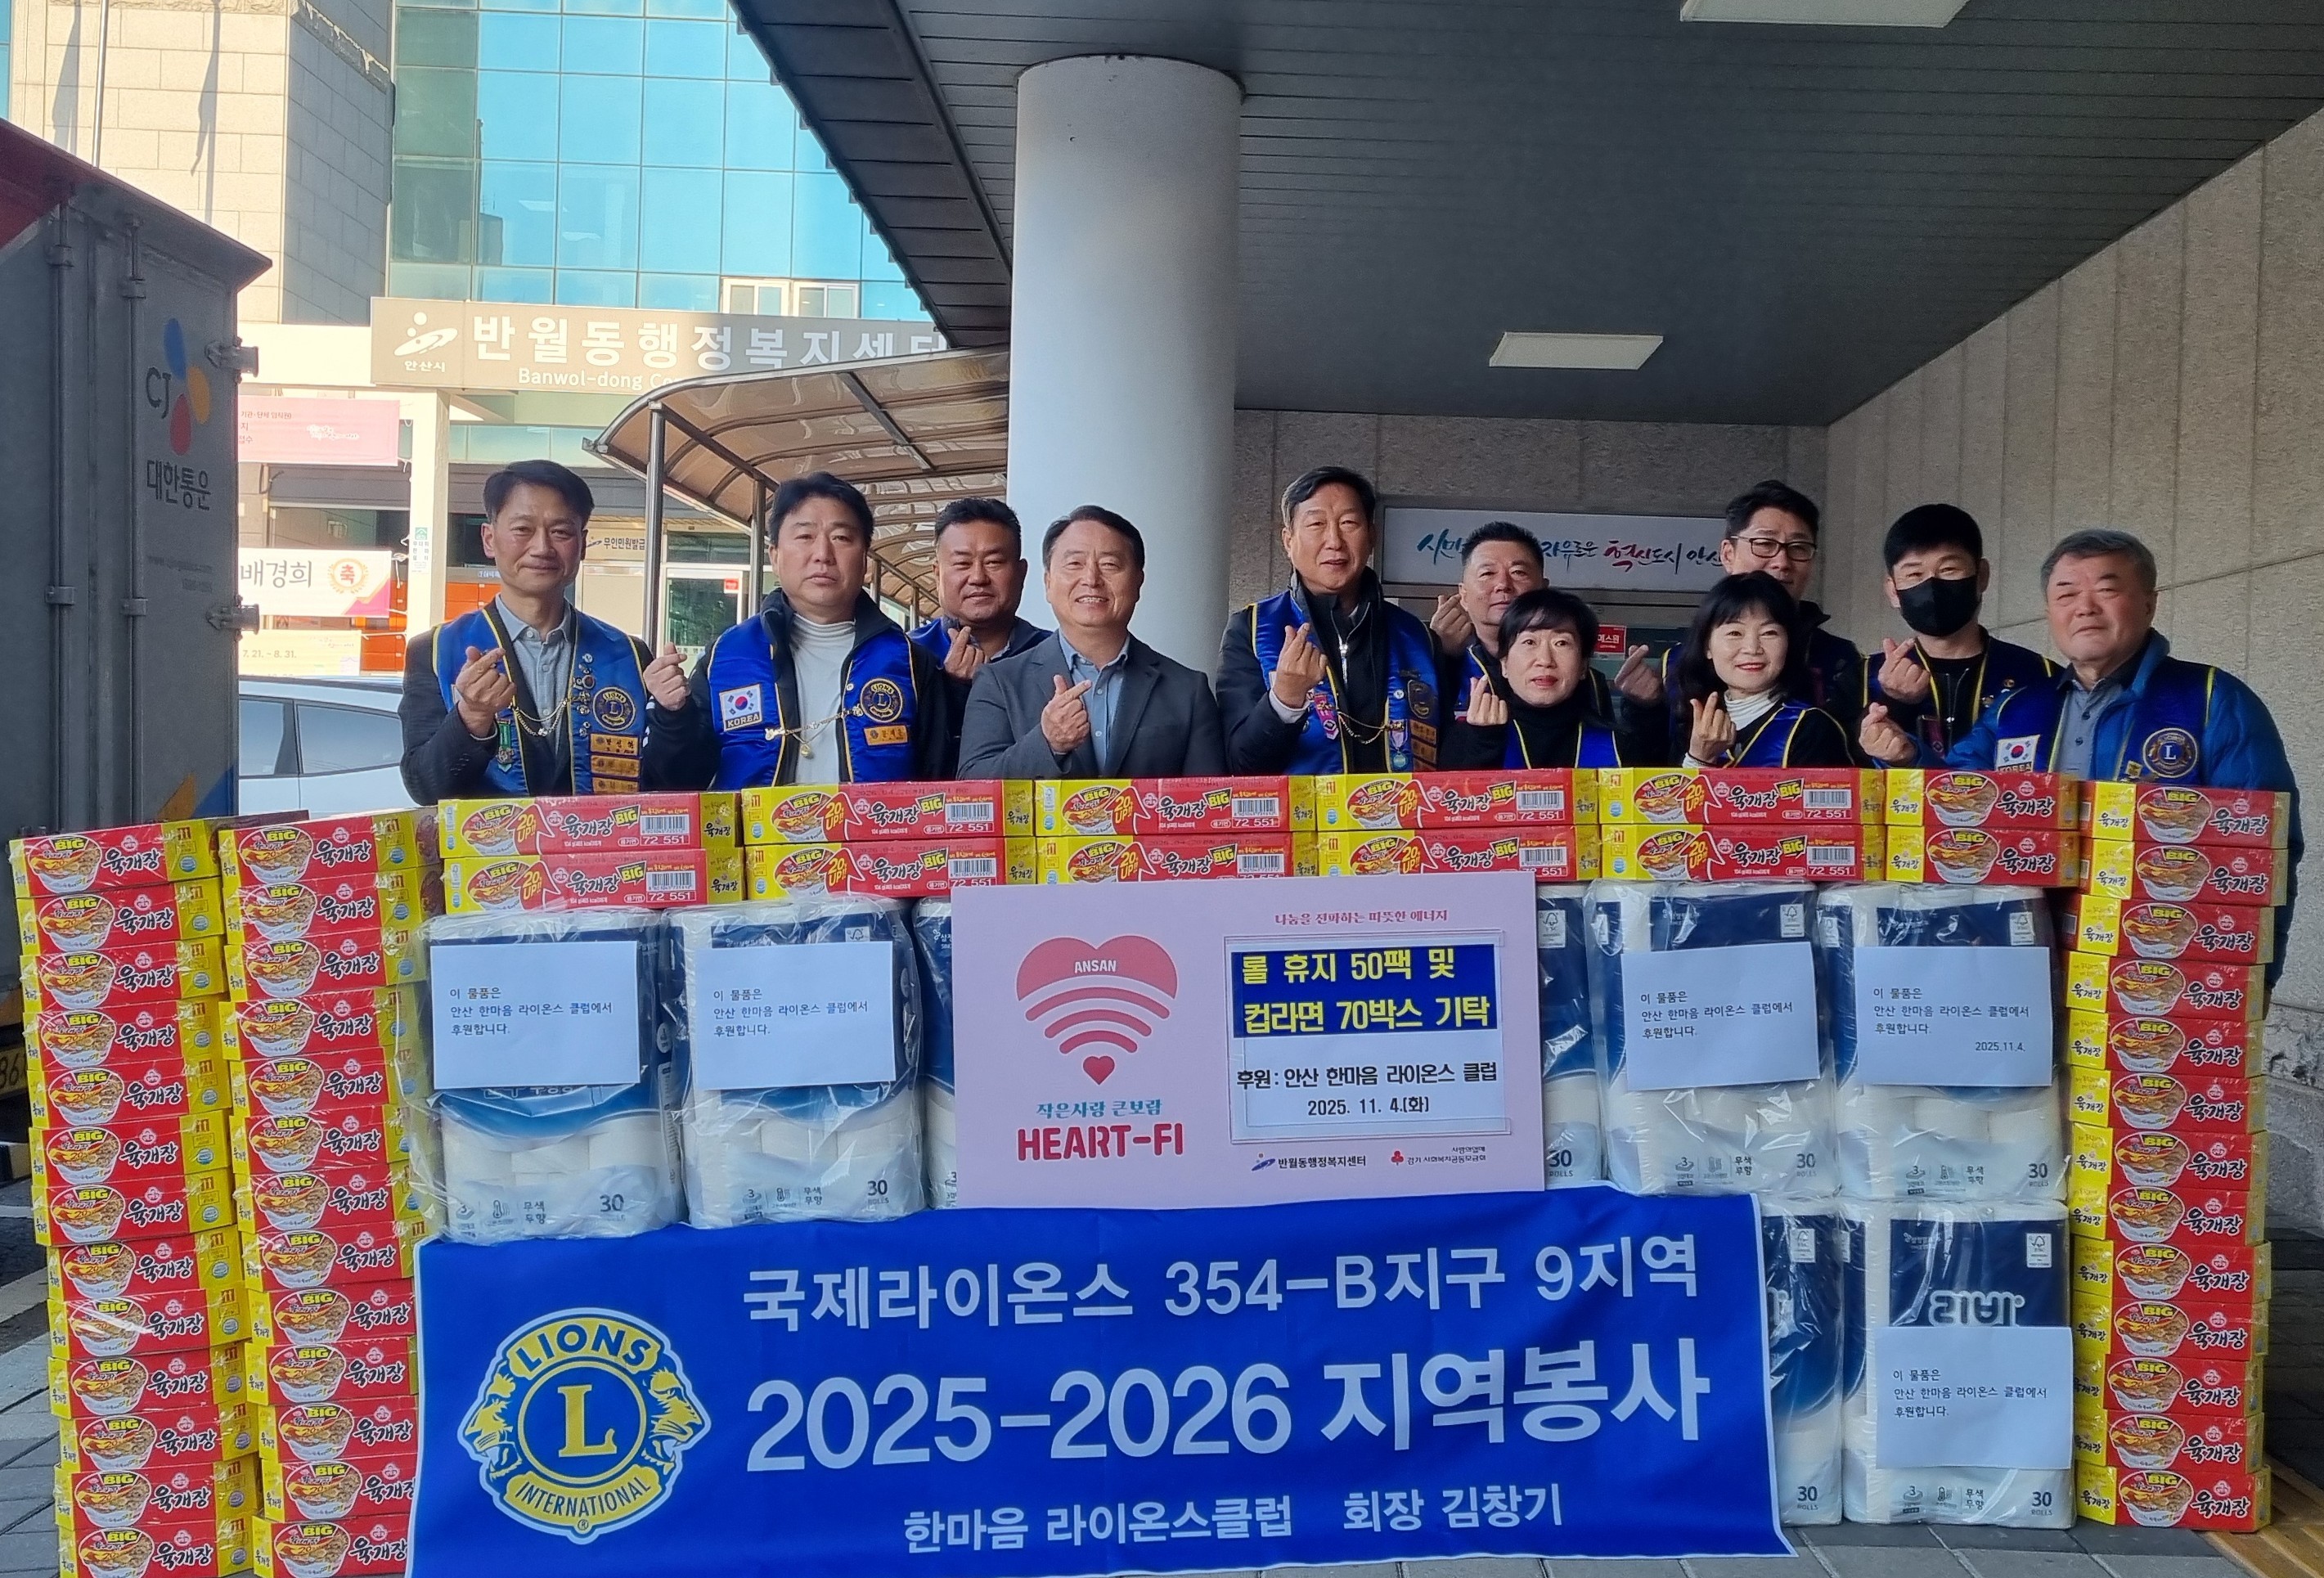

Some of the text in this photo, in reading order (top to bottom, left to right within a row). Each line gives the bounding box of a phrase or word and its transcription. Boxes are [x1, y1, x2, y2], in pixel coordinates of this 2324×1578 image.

[518, 366, 643, 390] Banwol-dong
[146, 460, 212, 511] 대한통운
[240, 558, 312, 588] 배경희
[727, 713, 760, 729] KOREA
[2164, 745, 2178, 760] L
[1443, 785, 1513, 813] 육개장 BIG
[1728, 783, 1801, 807] 육개장 BIG
[869, 798, 943, 825] 육개장 BIG
[1158, 793, 1229, 819] 육개장 BIG
[1807, 810, 1848, 819] 72 551
[1997, 792, 2056, 818] 육개장
[562, 809, 636, 837] 육개장 BIG
[949, 823, 990, 833] 72 551
[2209, 808, 2268, 834] 육개장
[55, 838, 84, 851] BIG
[641, 835, 683, 844] 72 551
[102, 848, 160, 875] 육개장
[314, 838, 371, 866] 육개장
[1274, 906, 1448, 927] 나눔을 전파하는 따뜻한 에너지
[1074, 958, 1117, 974] ANSAN
[1242, 947, 1455, 985] 롤 휴지 50팩 및
[450, 986, 502, 1000] 이 물품은
[712, 987, 762, 1002] 이 물품은
[1639, 991, 1688, 1005] 이 물품은
[1872, 987, 1922, 1000] 이 물품은
[2182, 981, 2242, 1010] 육개장
[451, 1001, 614, 1018] 안산 한마음 라이온스 클럽에서
[713, 1001, 869, 1020] 안산 한마음 라이온스 클럽에서
[1243, 995, 1490, 1034] 컵라면 70박스 기탁
[1641, 1000, 1793, 1023] 안산 한마음 라이온스 클럽에서
[1873, 1003, 2030, 1018] 안산 한마음 라이온스 클럽에서
[115, 1023, 174, 1051] 육개장
[451, 1022, 511, 1036] 후원합니다.
[713, 1024, 771, 1038] 후원합니다.
[1642, 1024, 1698, 1040] 후원합니다.
[1874, 1021, 1931, 1036] 후원합니다.
[1974, 1041, 2027, 1054] 2025.11.4.
[1283, 1066, 1319, 1090] 안산
[1325, 1065, 1378, 1088] 한마음
[1387, 1063, 1455, 1086] 라이온스
[1462, 1060, 1498, 1084] 클럽
[1036, 1097, 1162, 1120] 작은사랑 큰보람
[1307, 1099, 1352, 1117] 2025.
[1359, 1099, 1382, 1116] 11.
[1018, 1122, 1184, 1162] HEART-FI
[1278, 1155, 1367, 1169] 반월동행정복지센터
[1549, 1149, 1573, 1168] 30
[1735, 1155, 1753, 1167] 무색
[1796, 1153, 1816, 1169] 30
[2188, 1154, 2246, 1180] 육개장
[1966, 1164, 1985, 1176] 무색
[2029, 1162, 2048, 1179] 30
[803, 1185, 823, 1196] 무색
[867, 1179, 888, 1197] 30
[124, 1198, 182, 1225] 육개장
[599, 1194, 625, 1214] 30
[336, 1246, 395, 1274] 육개장
[743, 1233, 1699, 1332] 국제라이온스 354-B지구 9지역
[517, 1324, 658, 1371] LIONS
[1893, 1368, 1942, 1382] 이 물품은
[1894, 1384, 2048, 1401] 안산 한마음 라이온스 클럽에서
[745, 1337, 1712, 1473] 2025-2026 지역봉사
[1894, 1405, 1950, 1419] 후원합니다.
[556, 1384, 618, 1458] L
[157, 1427, 218, 1454] 육개장
[2147, 1474, 2178, 1486] BIG
[515, 1476, 652, 1520] INTERNATIONAL
[1796, 1486, 1818, 1502] 30
[1965, 1489, 1985, 1499] 무색
[2031, 1491, 2052, 1508] 30
[1966, 1499, 1985, 1511] 무향
[2193, 1491, 2251, 1519] 육개장
[903, 1483, 1563, 1554] 한마음 라이온스클럽 회장 김창기
